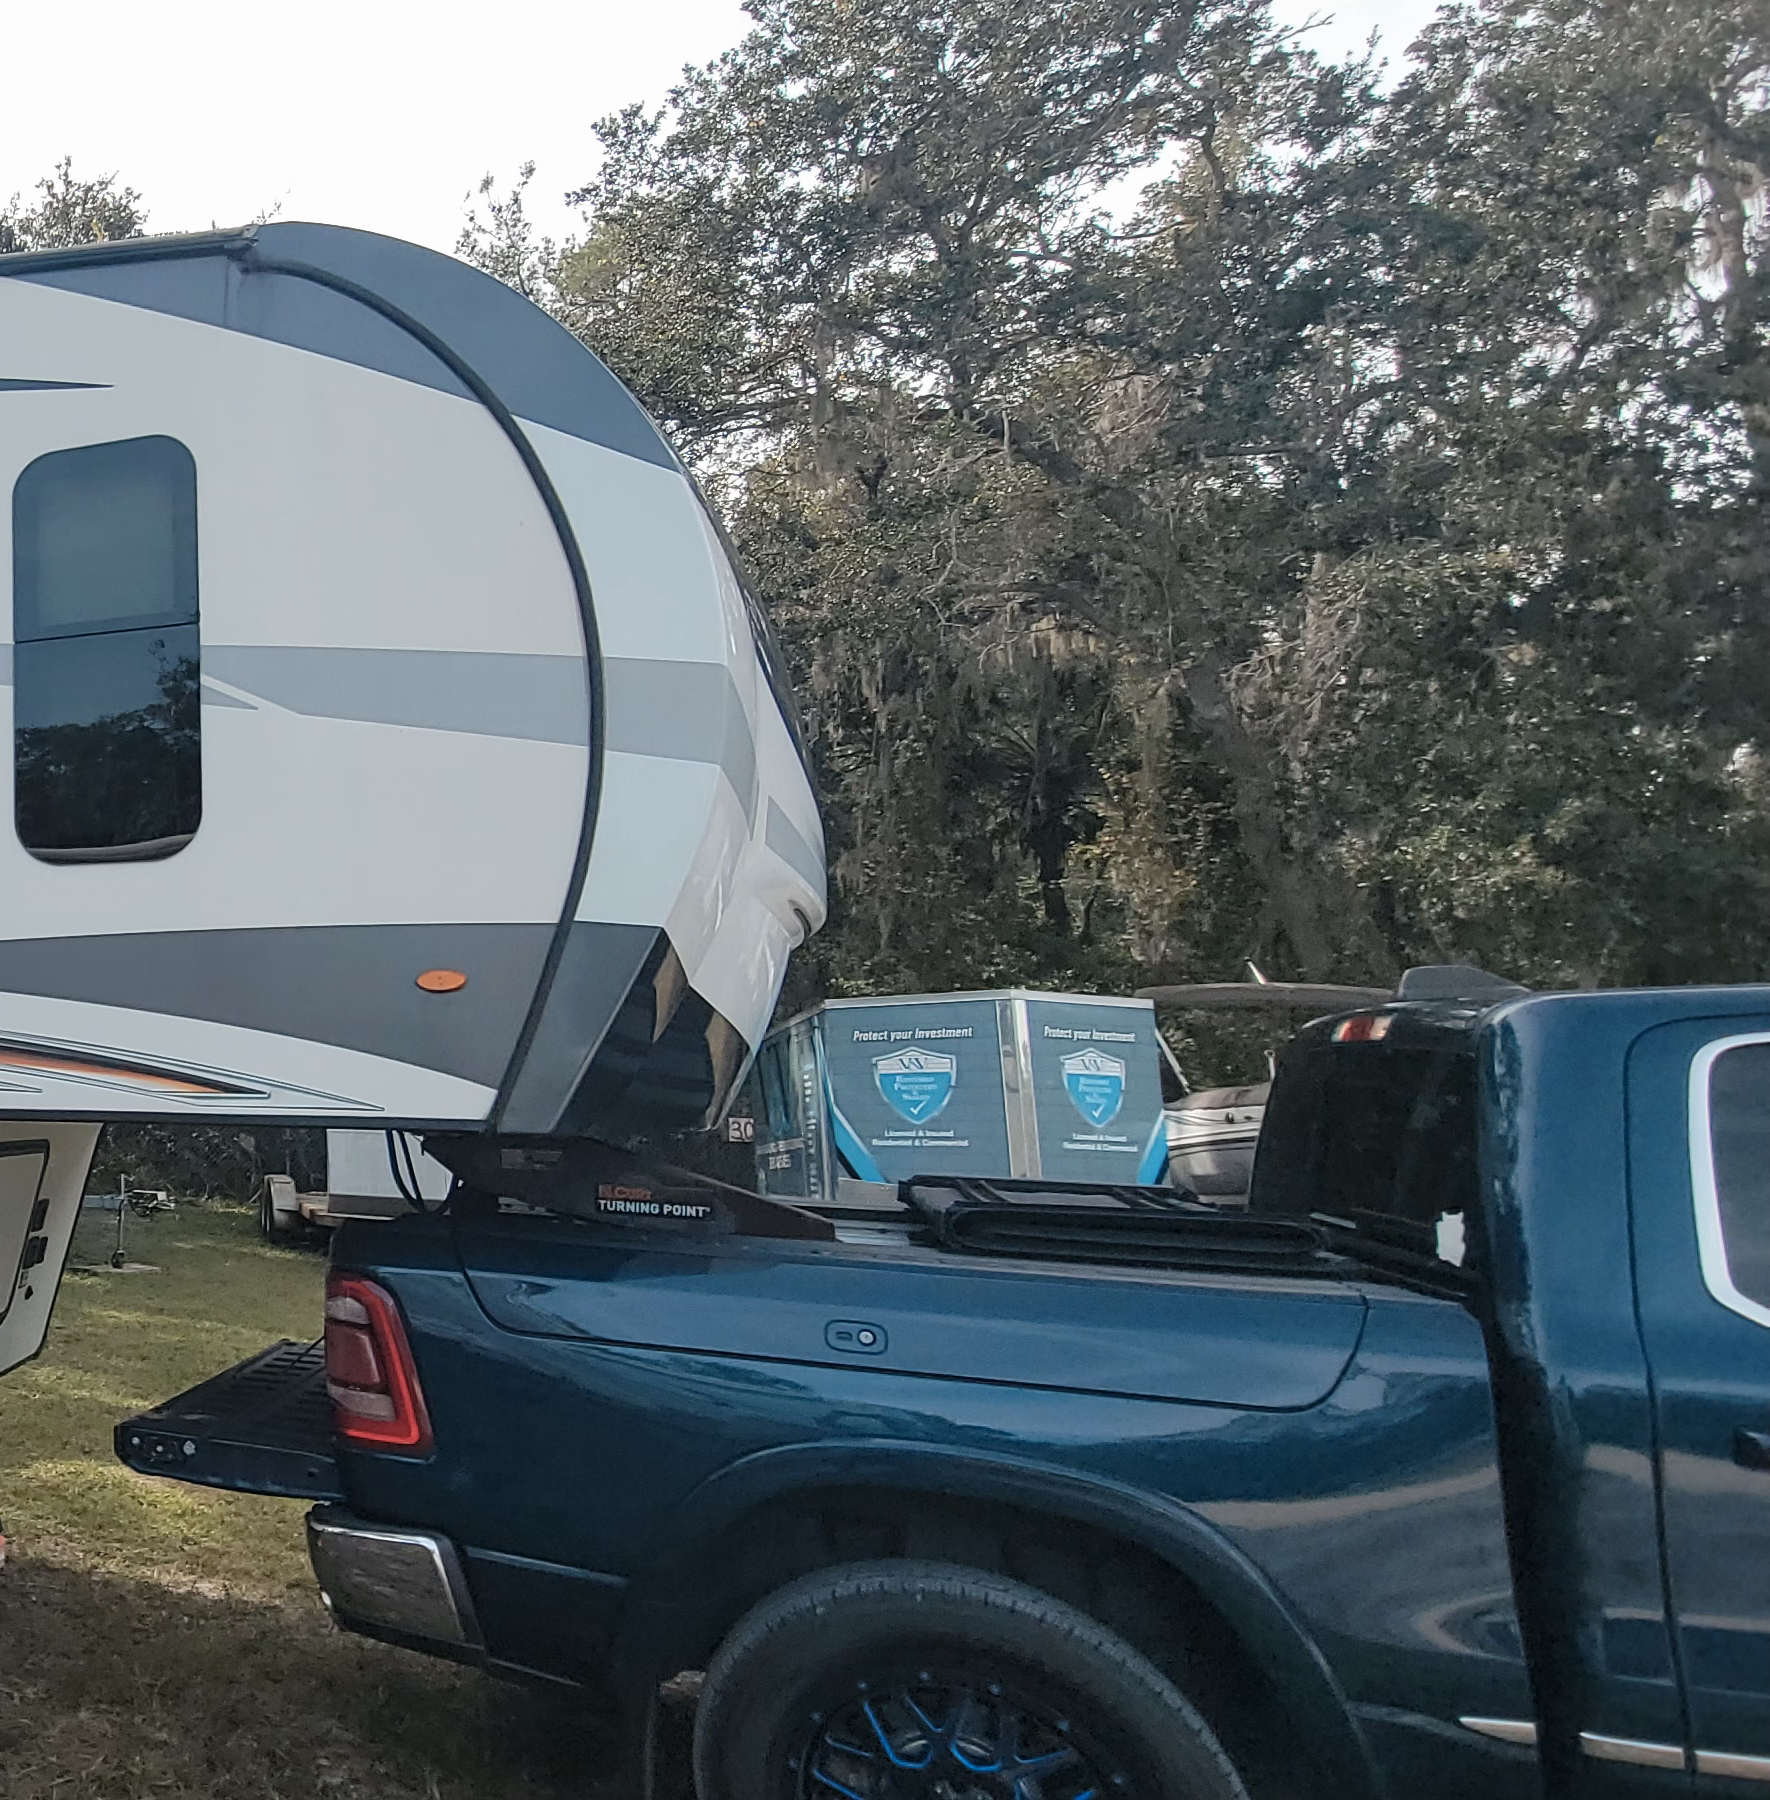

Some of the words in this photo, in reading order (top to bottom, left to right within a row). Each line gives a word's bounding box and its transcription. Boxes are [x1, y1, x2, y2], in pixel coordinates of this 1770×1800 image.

[852, 1029, 888, 1042] Protect
[890, 1030, 914, 1043] your
[914, 1026, 973, 1039] Investment
[731, 1121, 754, 1141] 30
[598, 1199, 660, 1215] TURNING
